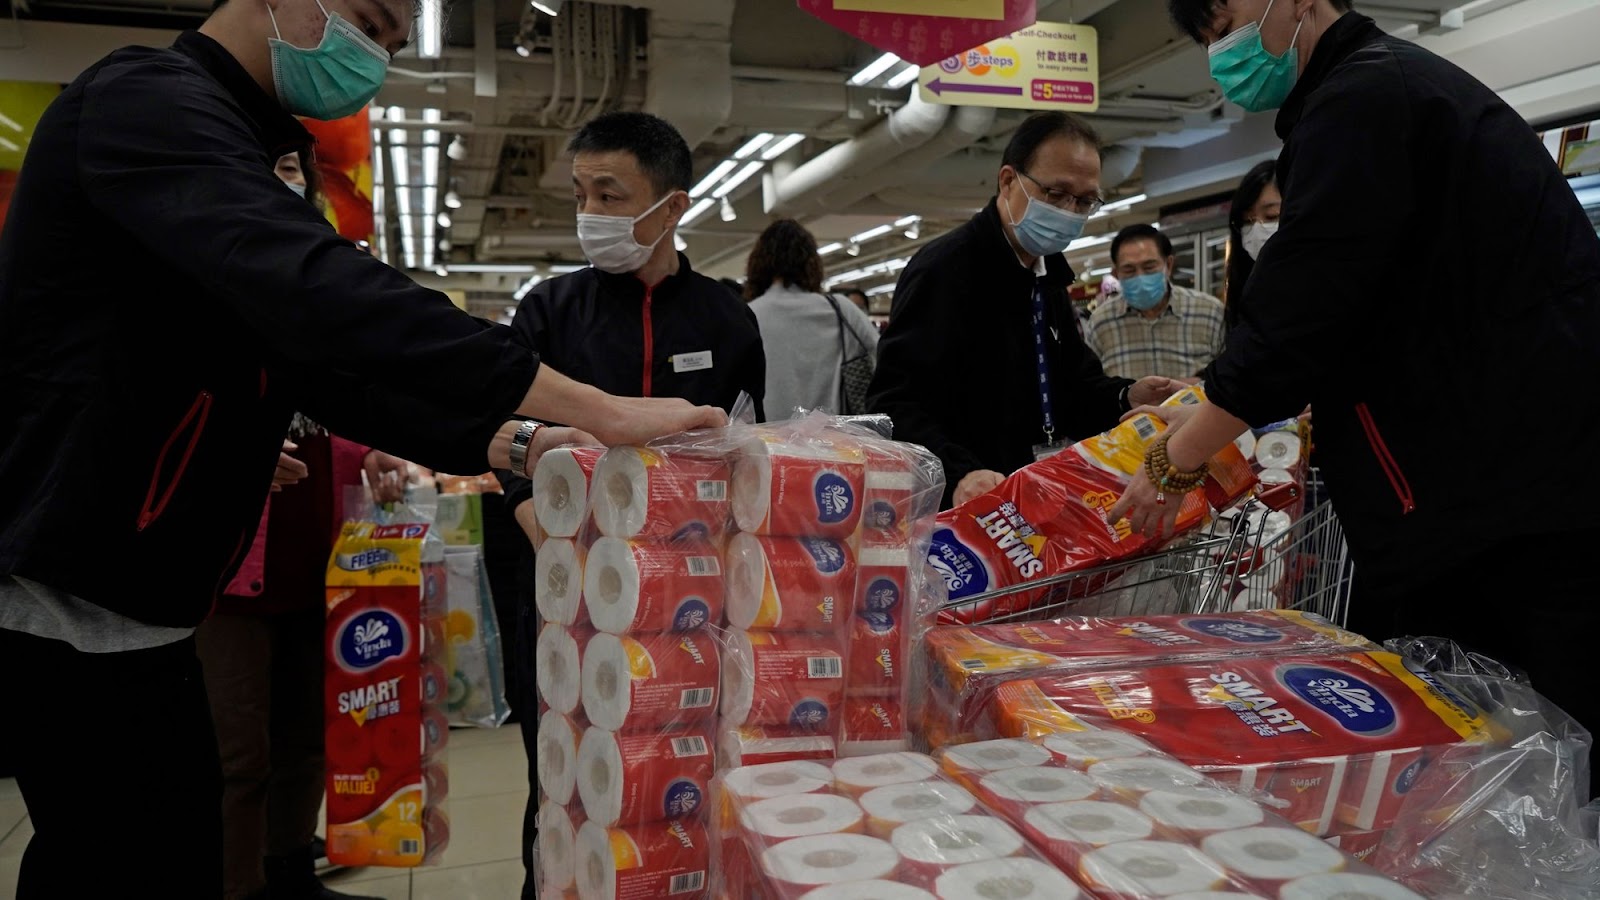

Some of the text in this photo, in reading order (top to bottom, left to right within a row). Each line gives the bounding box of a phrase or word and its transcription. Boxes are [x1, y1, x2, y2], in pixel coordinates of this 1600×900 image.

[982, 55, 1014, 68] steps
[1042, 83, 1053, 99] 5
[824, 485, 833, 515] Vinda
[976, 510, 1044, 579] SMART
[940, 543, 973, 585] Vinda
[353, 638, 392, 657] Vinda
[681, 636, 706, 665] SMART
[881, 648, 894, 678] SMART
[337, 678, 401, 714] SMART
[1209, 671, 1313, 733] SMART
[1307, 679, 1360, 719] Vinda
[872, 702, 893, 728] SMART
[1290, 776, 1323, 788] SMART
[397, 801, 417, 822] 12
[670, 820, 695, 850] SMART
